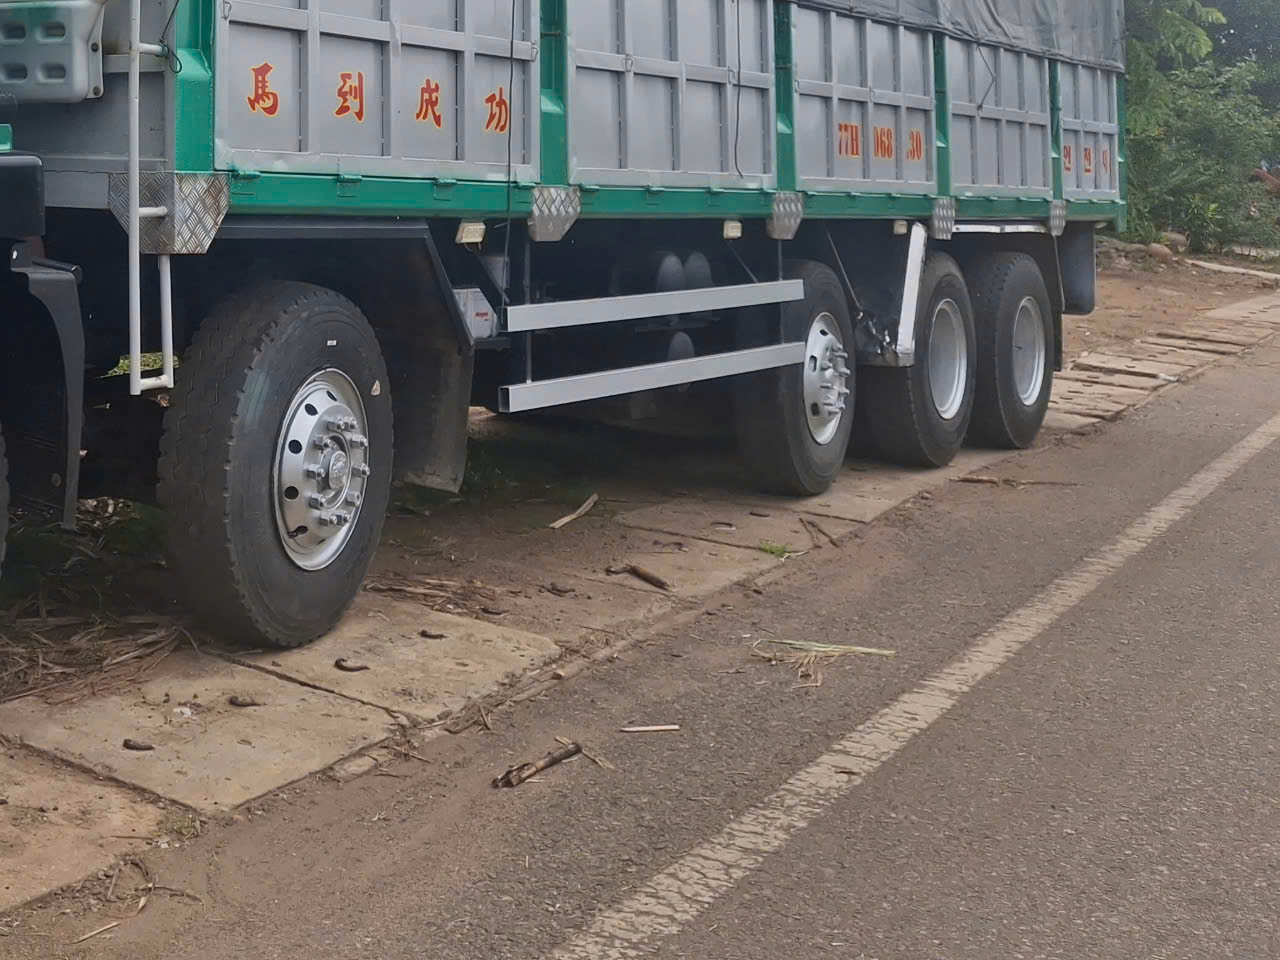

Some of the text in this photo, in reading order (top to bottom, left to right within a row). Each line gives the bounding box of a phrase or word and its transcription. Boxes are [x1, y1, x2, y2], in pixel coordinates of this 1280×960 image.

[247, 62, 510, 133] 馬到成功
[837, 123, 860, 156] 77H
